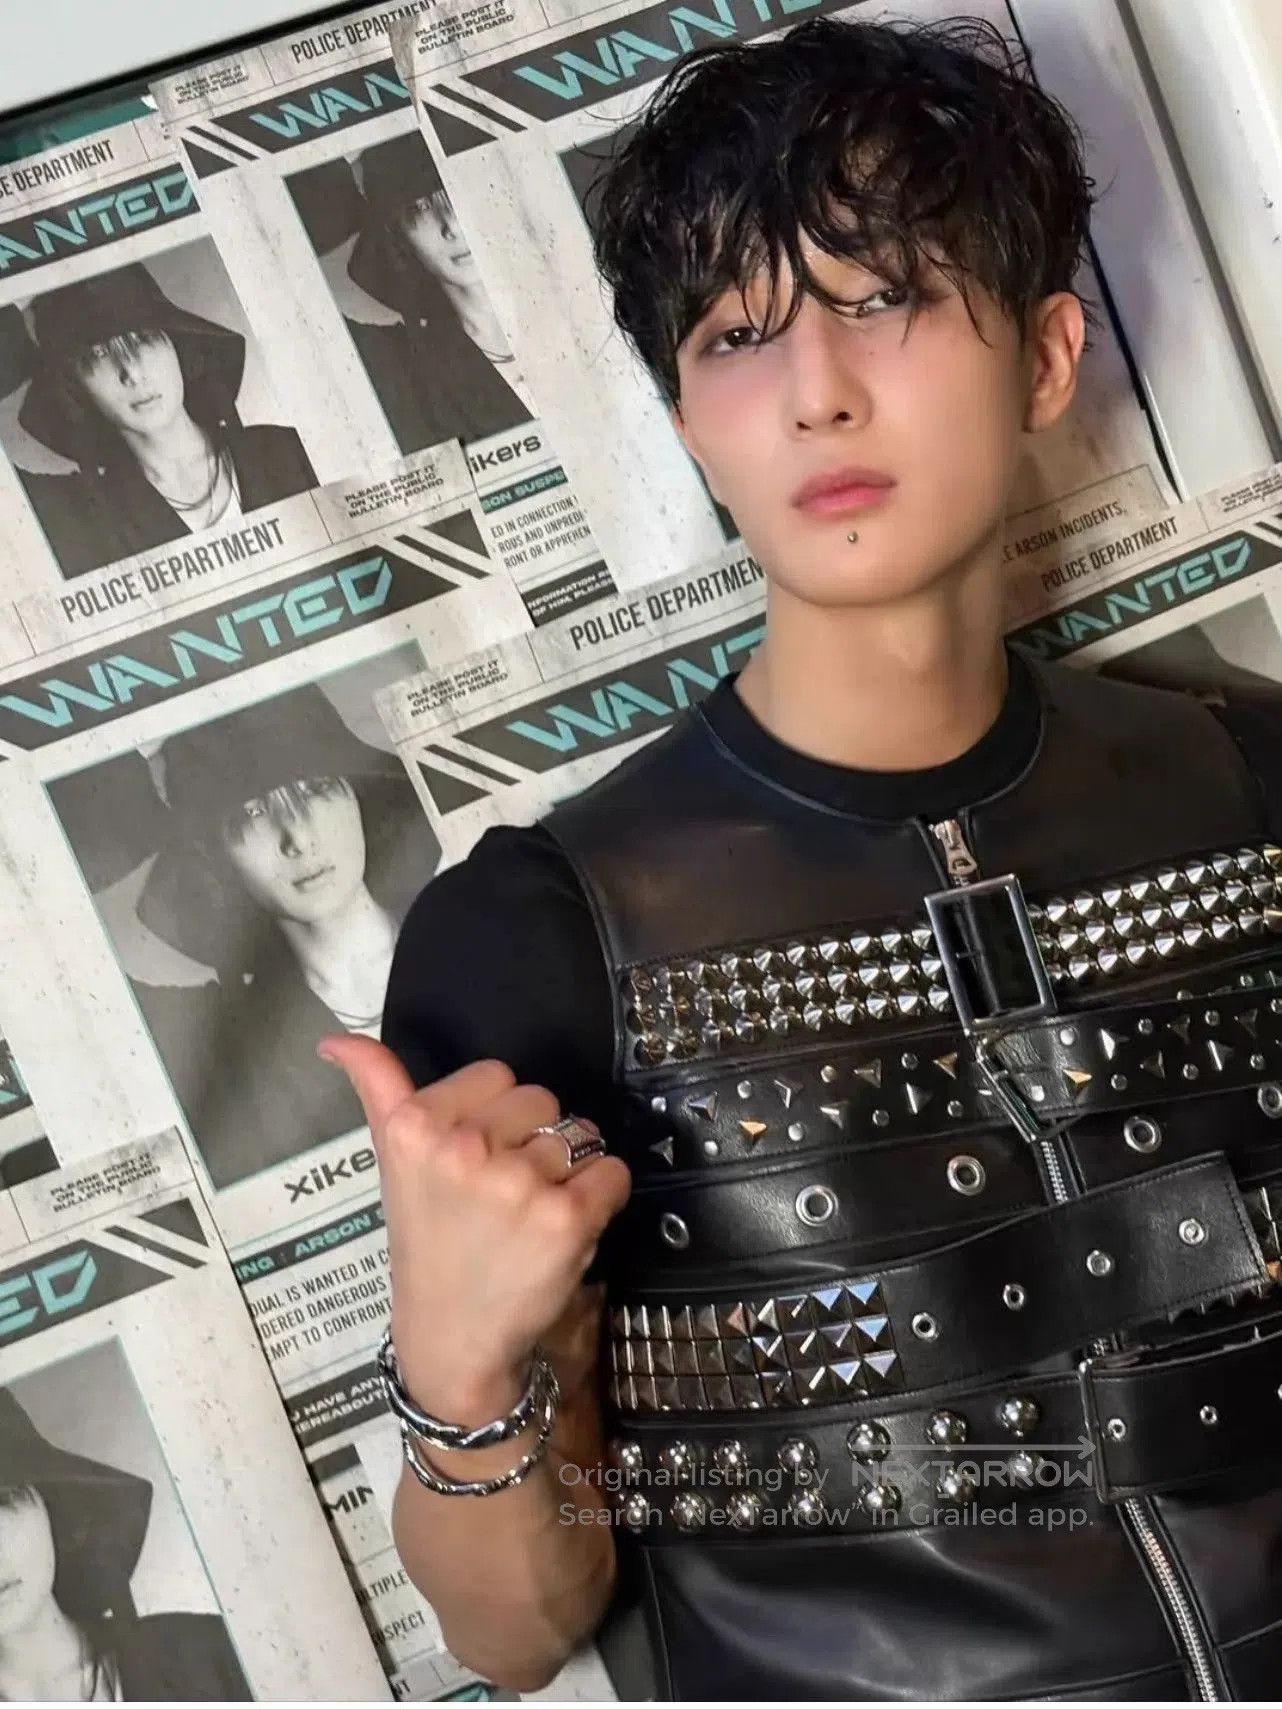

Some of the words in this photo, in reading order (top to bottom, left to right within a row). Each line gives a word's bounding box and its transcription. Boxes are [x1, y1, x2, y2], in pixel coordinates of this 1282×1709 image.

[292, 29, 345, 63] POLICE
[344, 0, 437, 44] DEPARTMEN
[0, 184, 13, 198] E
[13, 139, 115, 192] DEPARTMENT
[470, 435, 541, 473] ikers
[524, 527, 544, 543] AND
[1015, 527, 1059, 556] ARSON
[1041, 557, 1089, 592] POLICE
[1090, 516, 1178, 569] DEPARTMENT
[60, 572, 141, 623] POLICE
[140, 518, 285, 594] DEPARTMENT
[2, 556, 394, 728] WANTED
[569, 601, 645, 650] POLICE
[284, 1148, 377, 1204] xike
[295, 1214, 372, 1257] ARSON
[286, 1285, 301, 1303] IS
[301, 1263, 359, 1295] WANTED
[360, 1254, 377, 1273] IN
[260, 1308, 305, 1339] DERED
[306, 1276, 387, 1318] DANGEROUS
[270, 1335, 301, 1360] MPT
[302, 1326, 321, 1345] TO
[323, 1297, 392, 1337] CONFRONT
